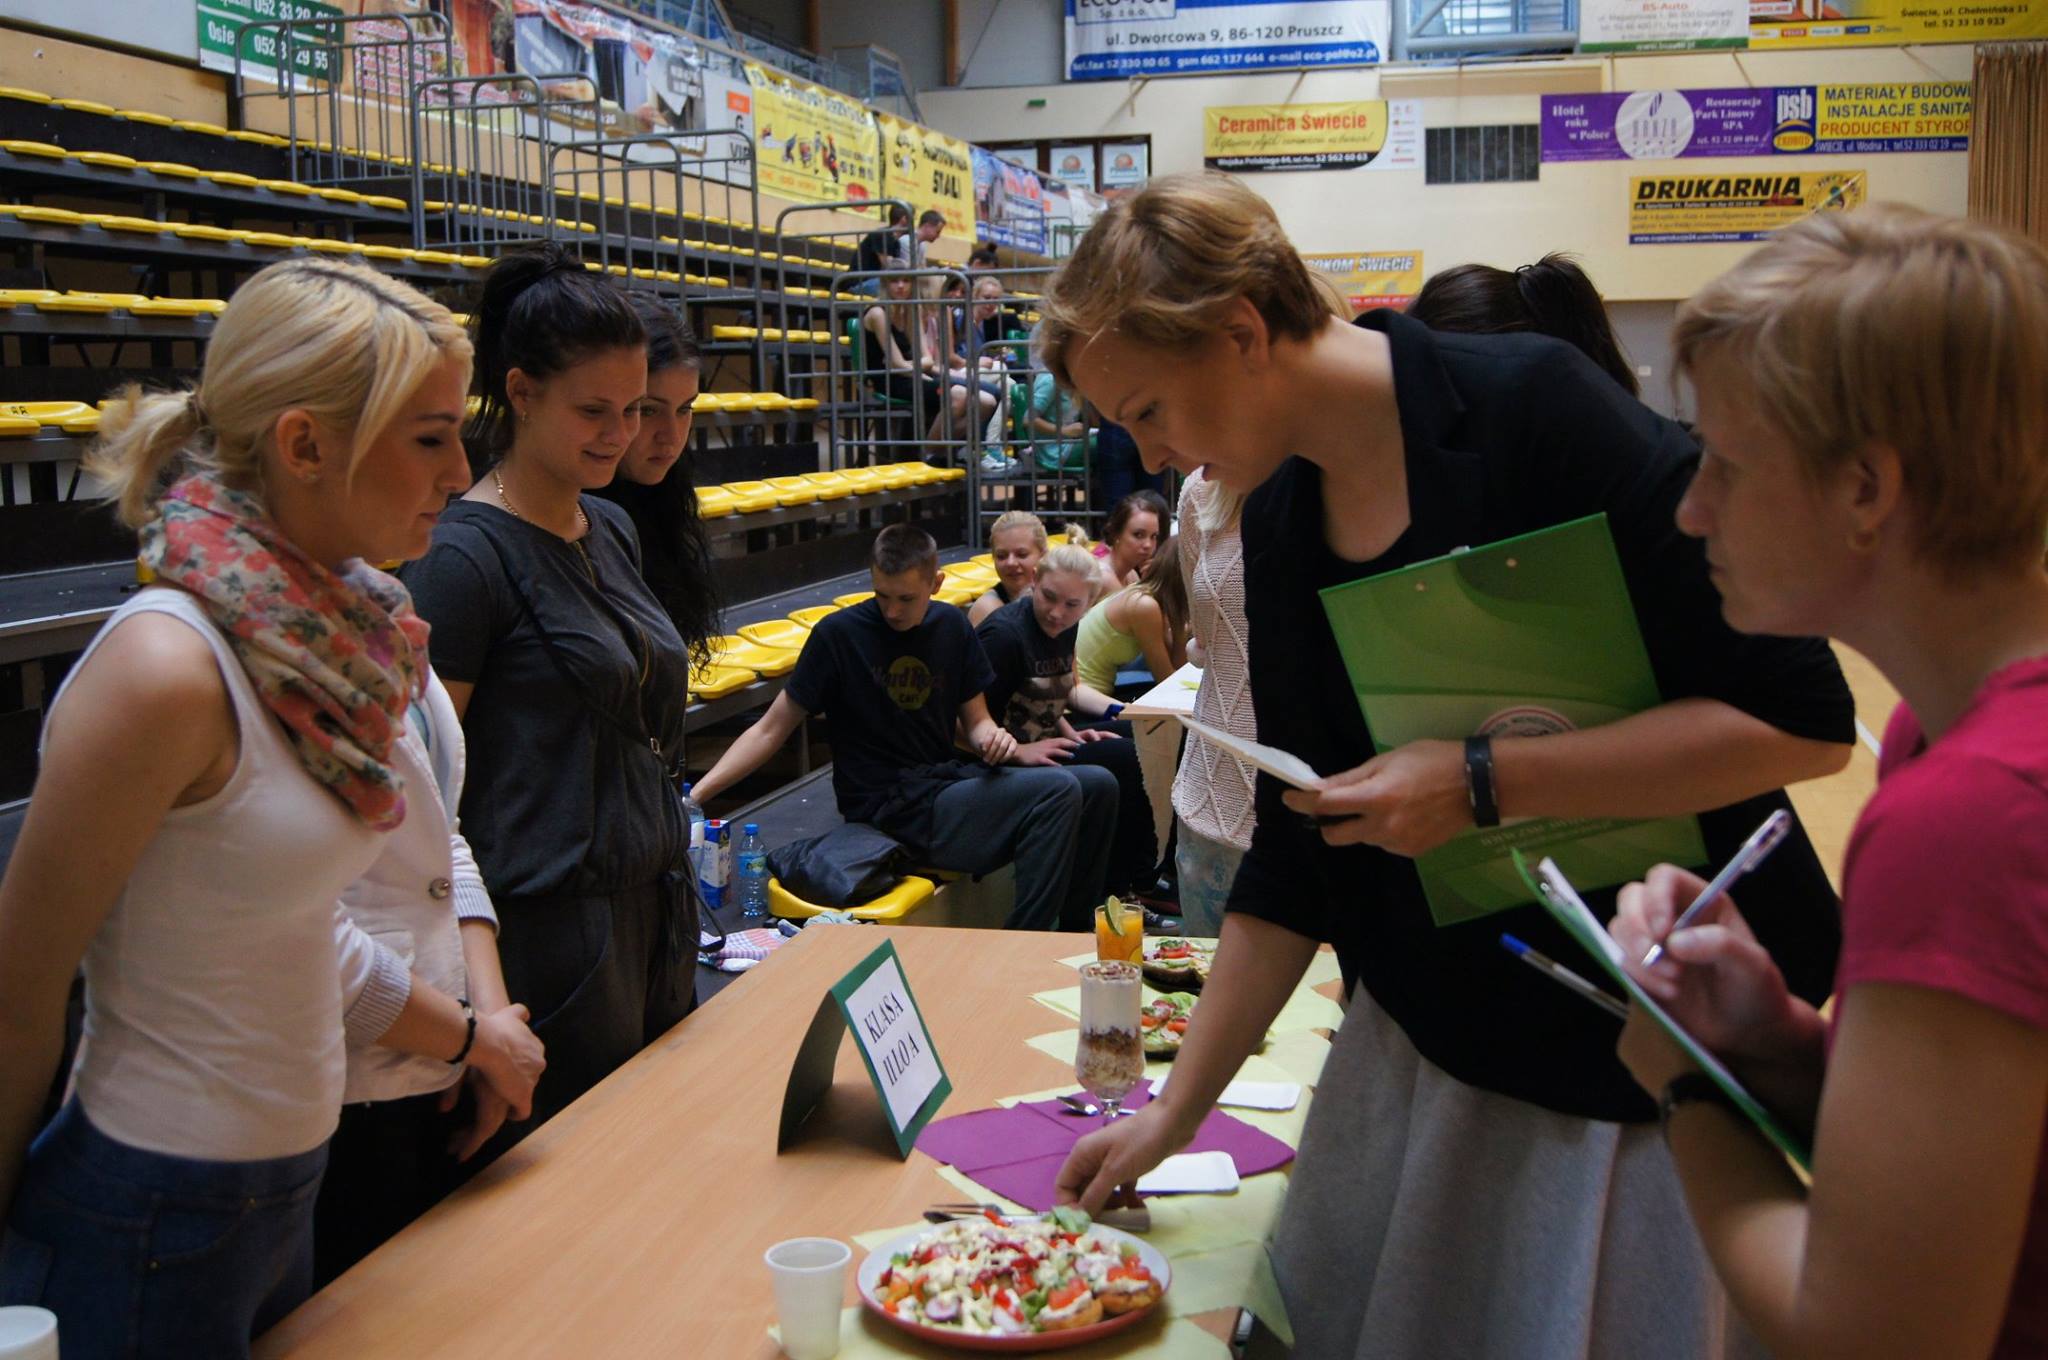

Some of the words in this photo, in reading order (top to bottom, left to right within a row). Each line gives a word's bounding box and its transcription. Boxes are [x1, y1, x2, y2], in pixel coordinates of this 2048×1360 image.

[1923, 19, 1939, 29] tel.
[208, 21, 236, 46] Osie
[1106, 33, 1125, 46] ul.
[1129, 31, 1206, 45] Dworcowa
[1210, 29, 1223, 42] 9,
[1228, 26, 1284, 41] 86-120
[1288, 25, 1344, 37] Pruszcz
[253, 34, 277, 57] 052
[1177, 56, 1199, 68] gsm
[1267, 51, 1302, 62] e-mail
[1825, 85, 1906, 101] MATERIAŁY
[1912, 84, 1970, 99] BUDOW
[1552, 104, 1585, 117] Hotel
[1705, 97, 1763, 110] Restauracja
[1776, 88, 1813, 124] psb
[1827, 103, 1915, 118] INSTALACJE
[1219, 115, 1296, 133] Ceramica
[1302, 109, 1367, 130] Świecie
[1693, 109, 1719, 120] Park
[1720, 108, 1756, 120] Linowy
[735, 115, 744, 130] G
[1722, 120, 1743, 131] SPA
[1820, 121, 1910, 136] PRODUCENT
[1579, 129, 1611, 141] Polsce
[1637, 176, 1801, 200] DRUKARNIA
[863, 991, 904, 1044] KLASA
